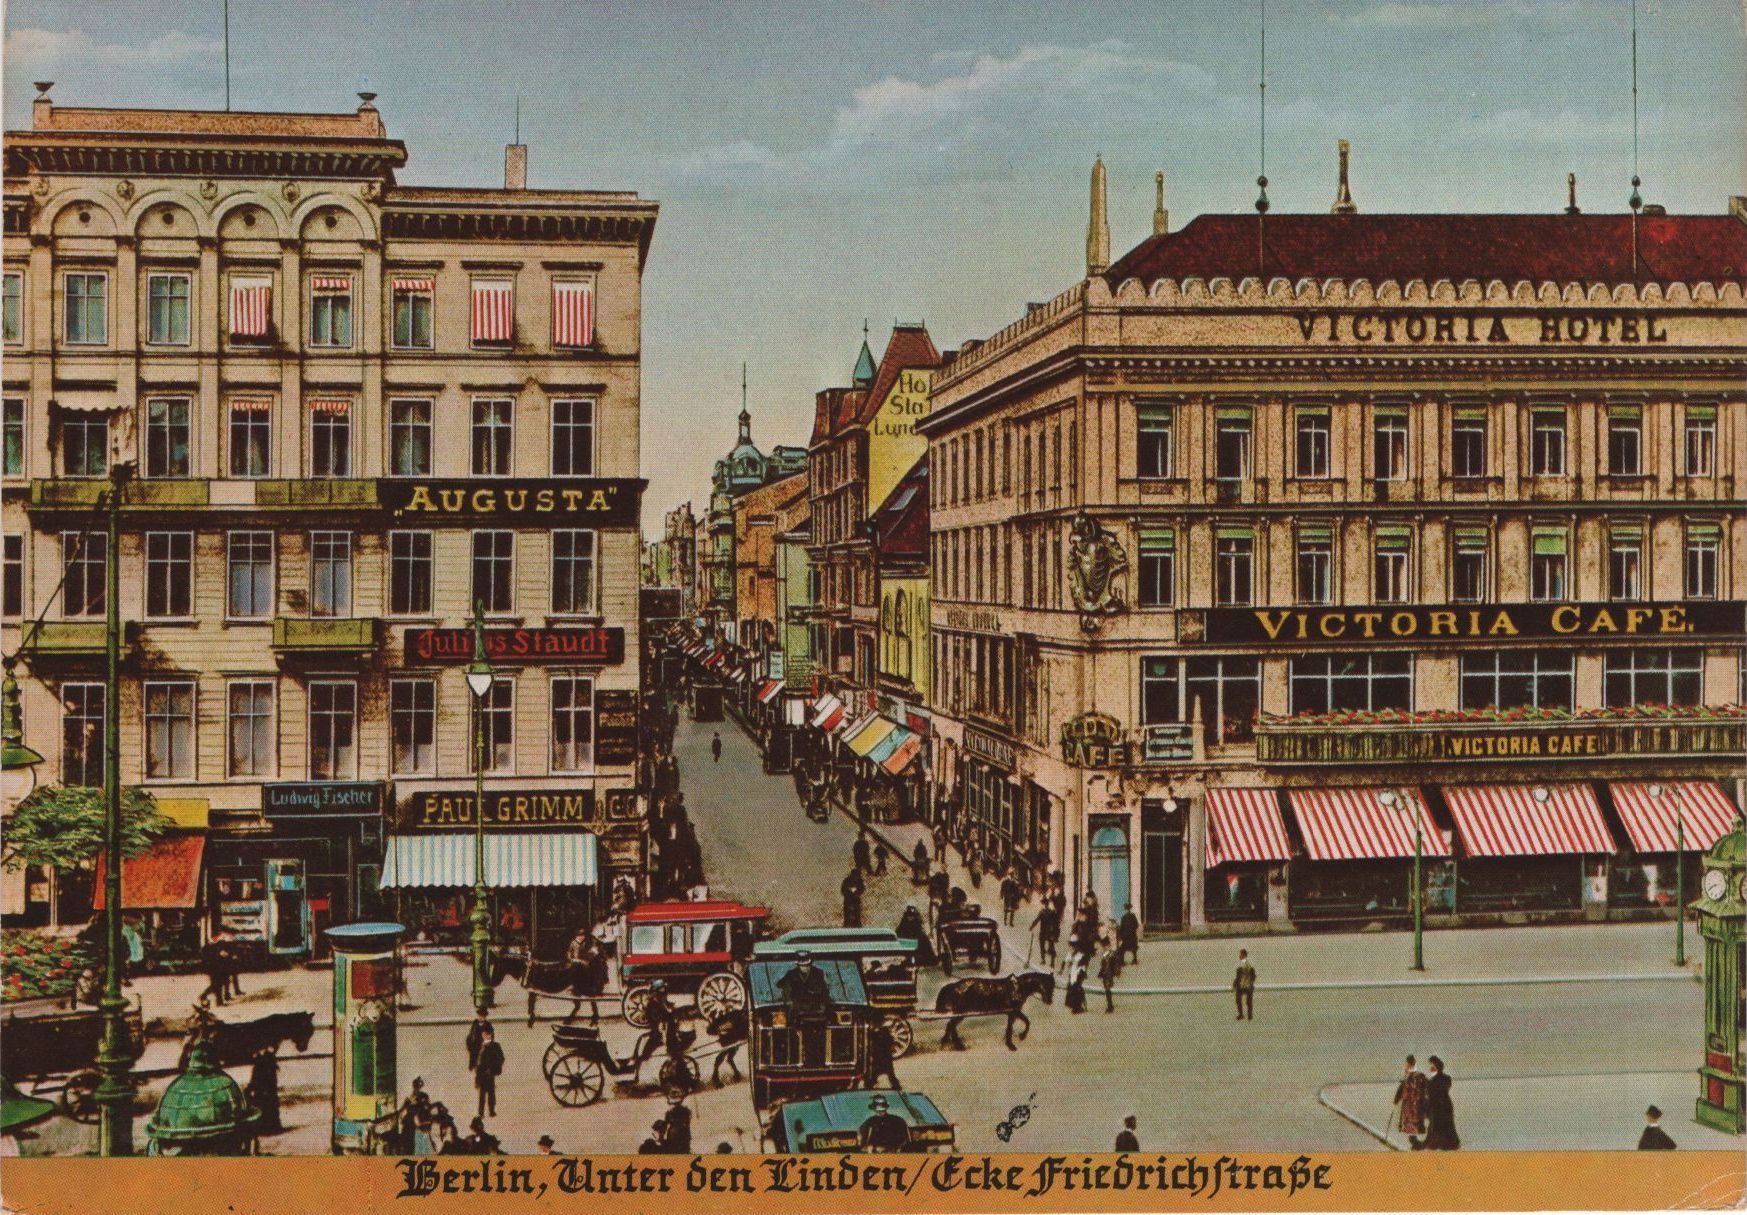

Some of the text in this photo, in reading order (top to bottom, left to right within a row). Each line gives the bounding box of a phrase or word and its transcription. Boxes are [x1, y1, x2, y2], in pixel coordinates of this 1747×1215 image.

[1299, 316, 1668, 343] VICTORIA HOTEL
[1253, 609, 1519, 640] VICTORIA
[512, 629, 610, 655] Staudt
[1548, 734, 1597, 754] CAFE
[271, 785, 374, 809] Ludwig Fischer
[497, 795, 584, 822] GRIMM
